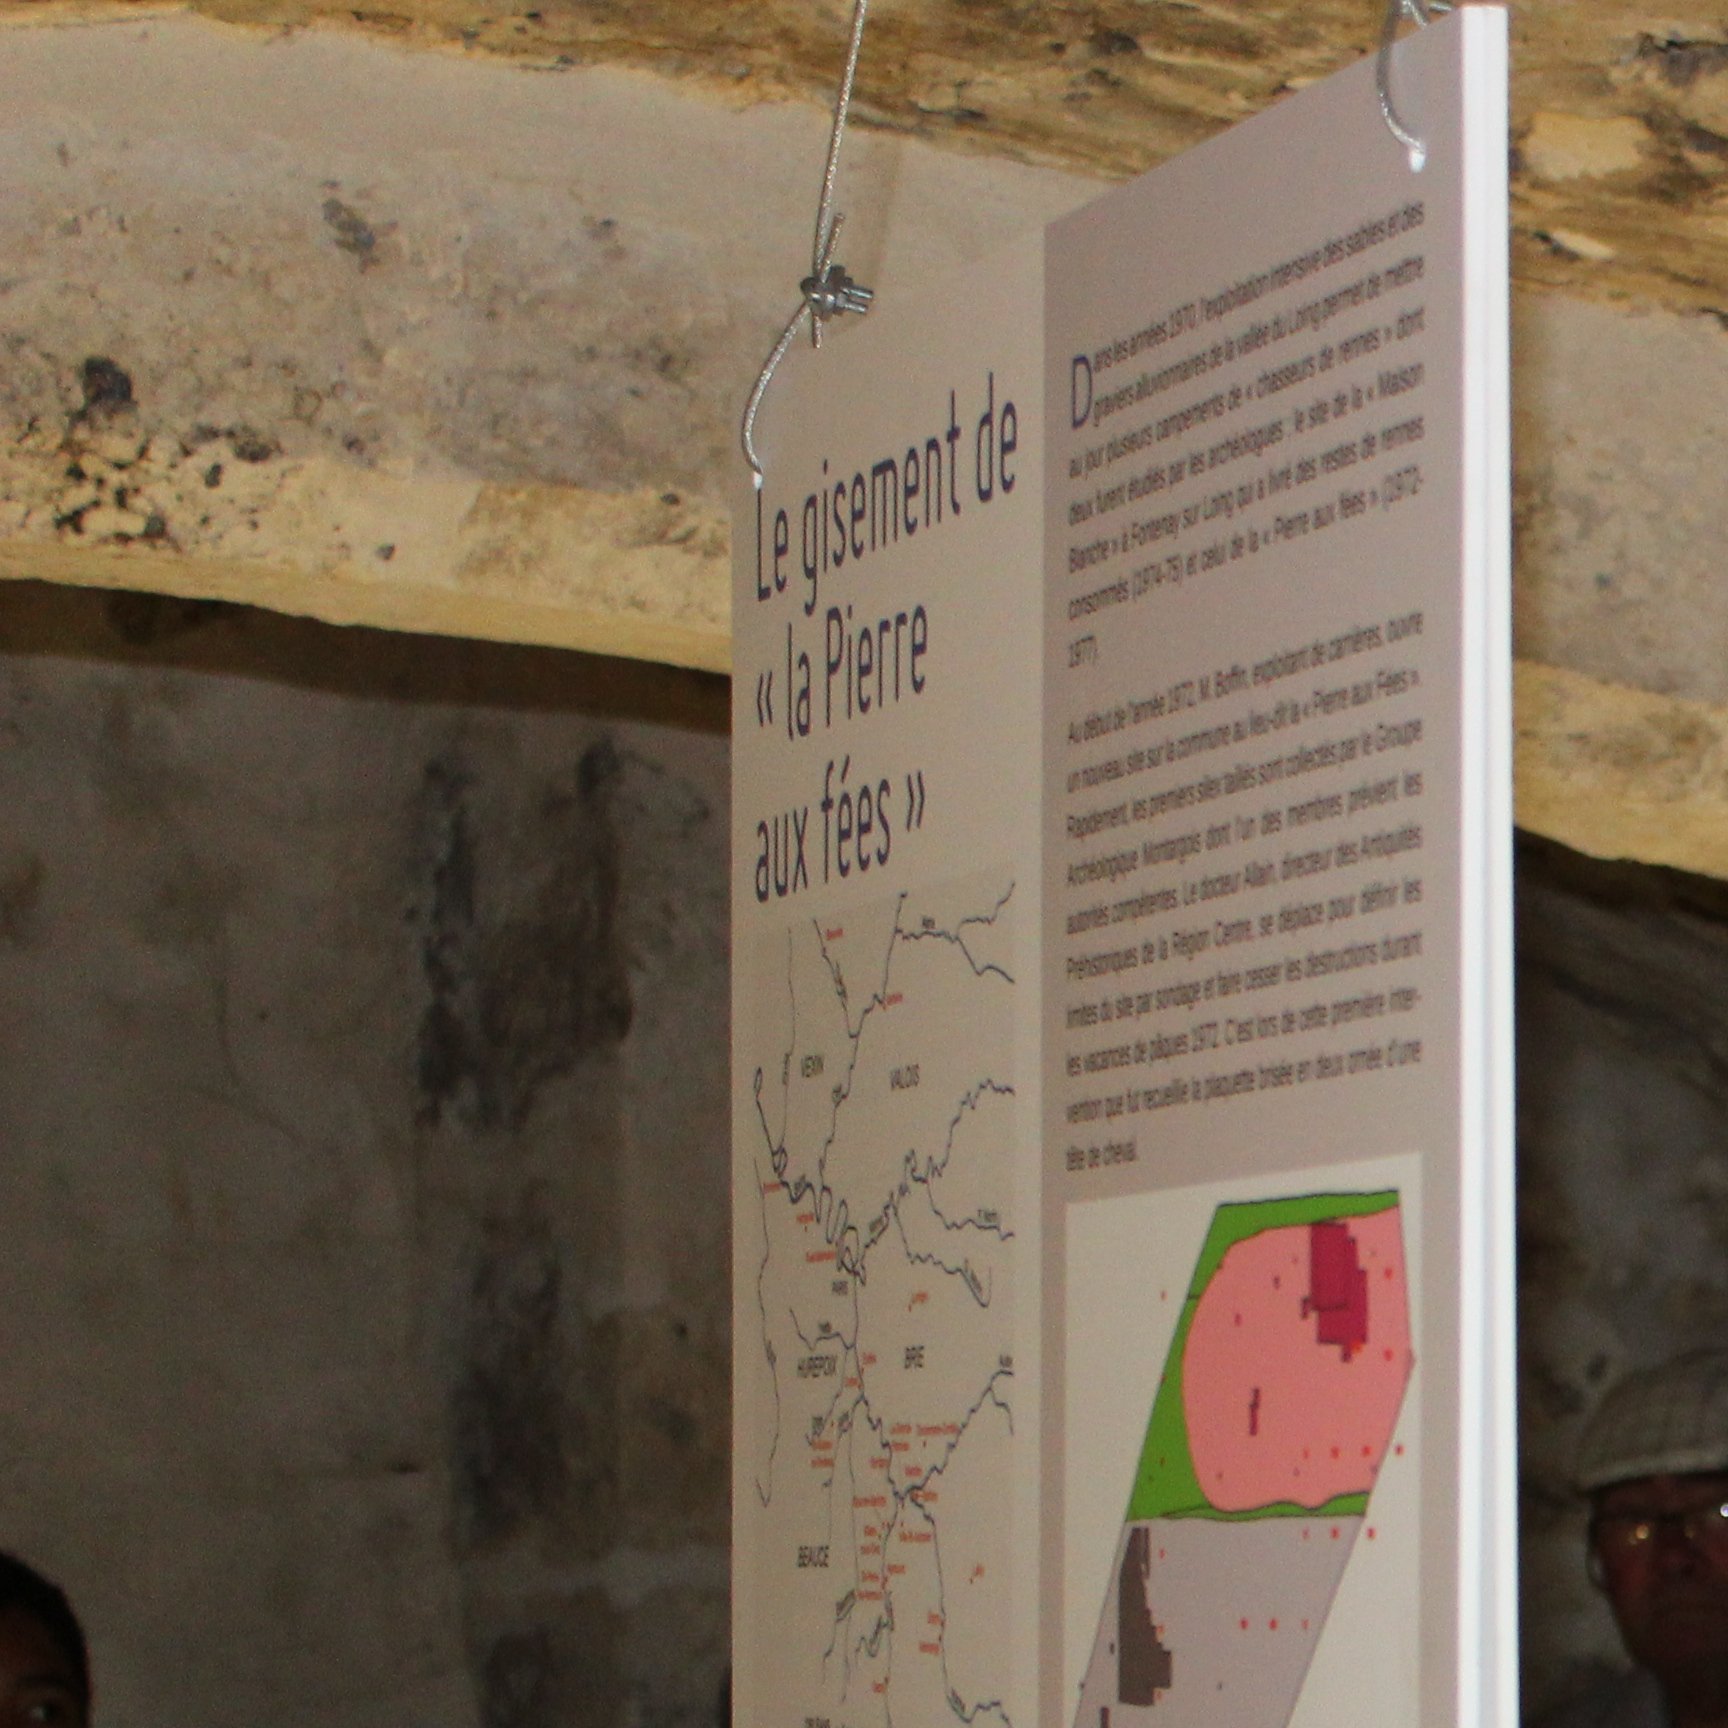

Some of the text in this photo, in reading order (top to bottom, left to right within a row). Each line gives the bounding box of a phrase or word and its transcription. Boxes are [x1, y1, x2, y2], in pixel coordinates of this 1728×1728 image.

[757, 371, 1017, 616] Le gisement de
[756, 604, 928, 741] « la Pierre
[755, 755, 926, 903] aux fées »
[801, 1055, 824, 1077] VEXIN
[891, 1065, 920, 1090] VALOIS
[904, 1345, 924, 1369] BRIE
[798, 1545, 829, 1568] BEAUCE
